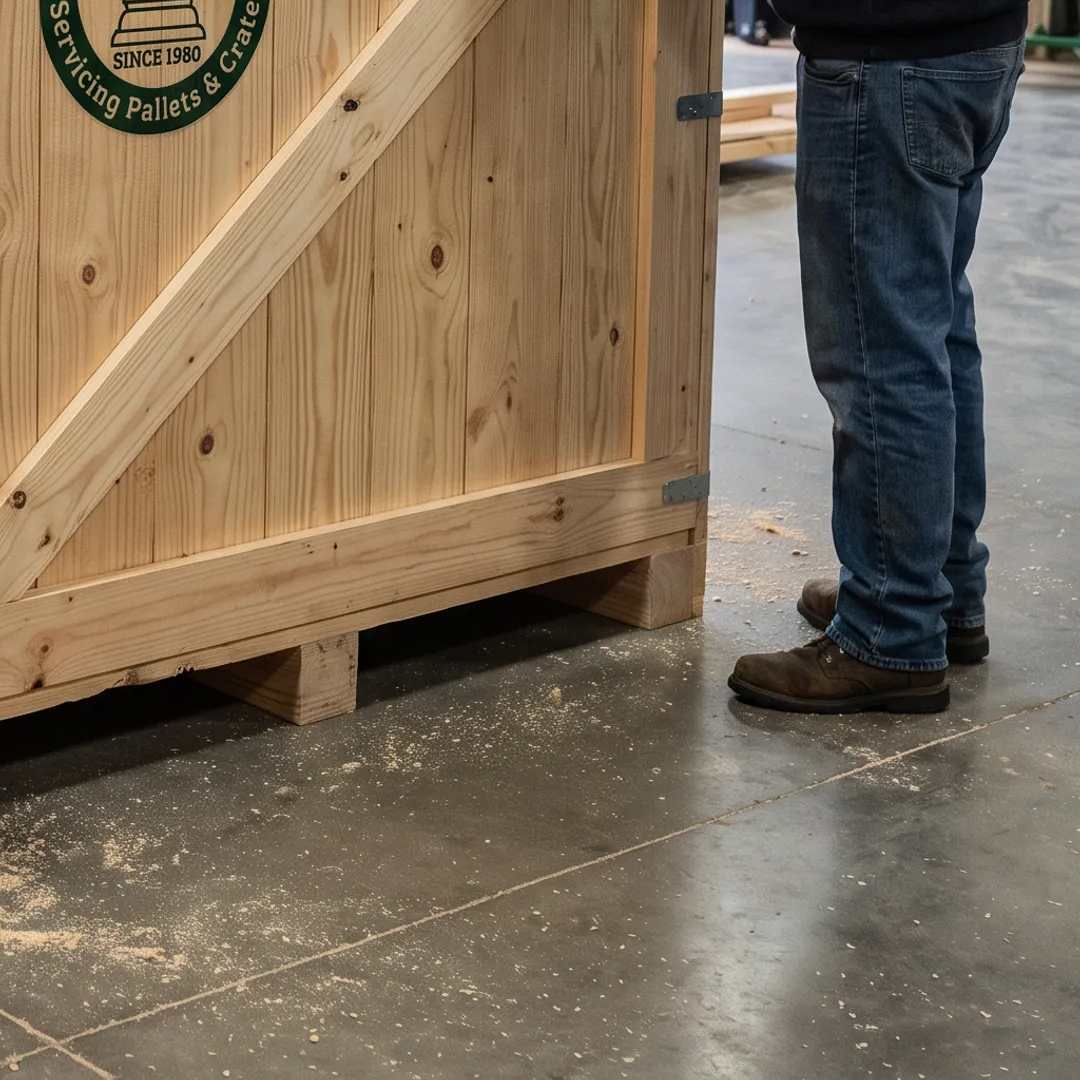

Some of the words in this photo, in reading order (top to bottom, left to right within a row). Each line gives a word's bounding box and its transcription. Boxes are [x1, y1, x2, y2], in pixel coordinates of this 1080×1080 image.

[49, 0, 121, 120] Servicing
[125, 88, 202, 122] Pallets
[203, 71, 222, 96] &
[113, 48, 163, 70] SINCE
[166, 45, 202, 65] 1980
